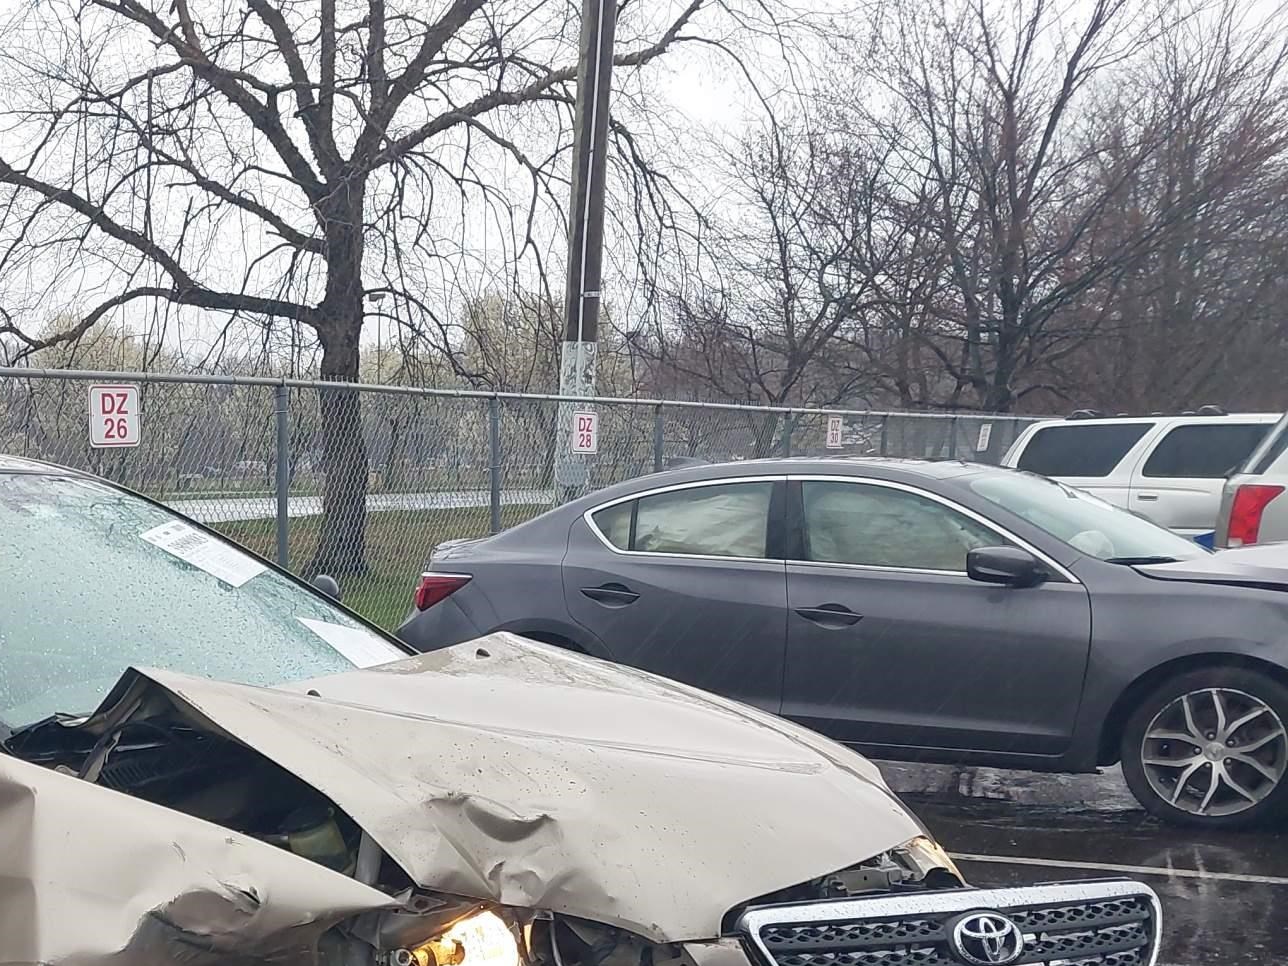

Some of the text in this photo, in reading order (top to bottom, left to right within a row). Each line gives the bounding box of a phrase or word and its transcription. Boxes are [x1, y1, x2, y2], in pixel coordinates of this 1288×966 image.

[101, 393, 129, 415] DZ
[104, 418, 128, 440] 26
[579, 417, 592, 433] DZ
[579, 433, 592, 448] 28
